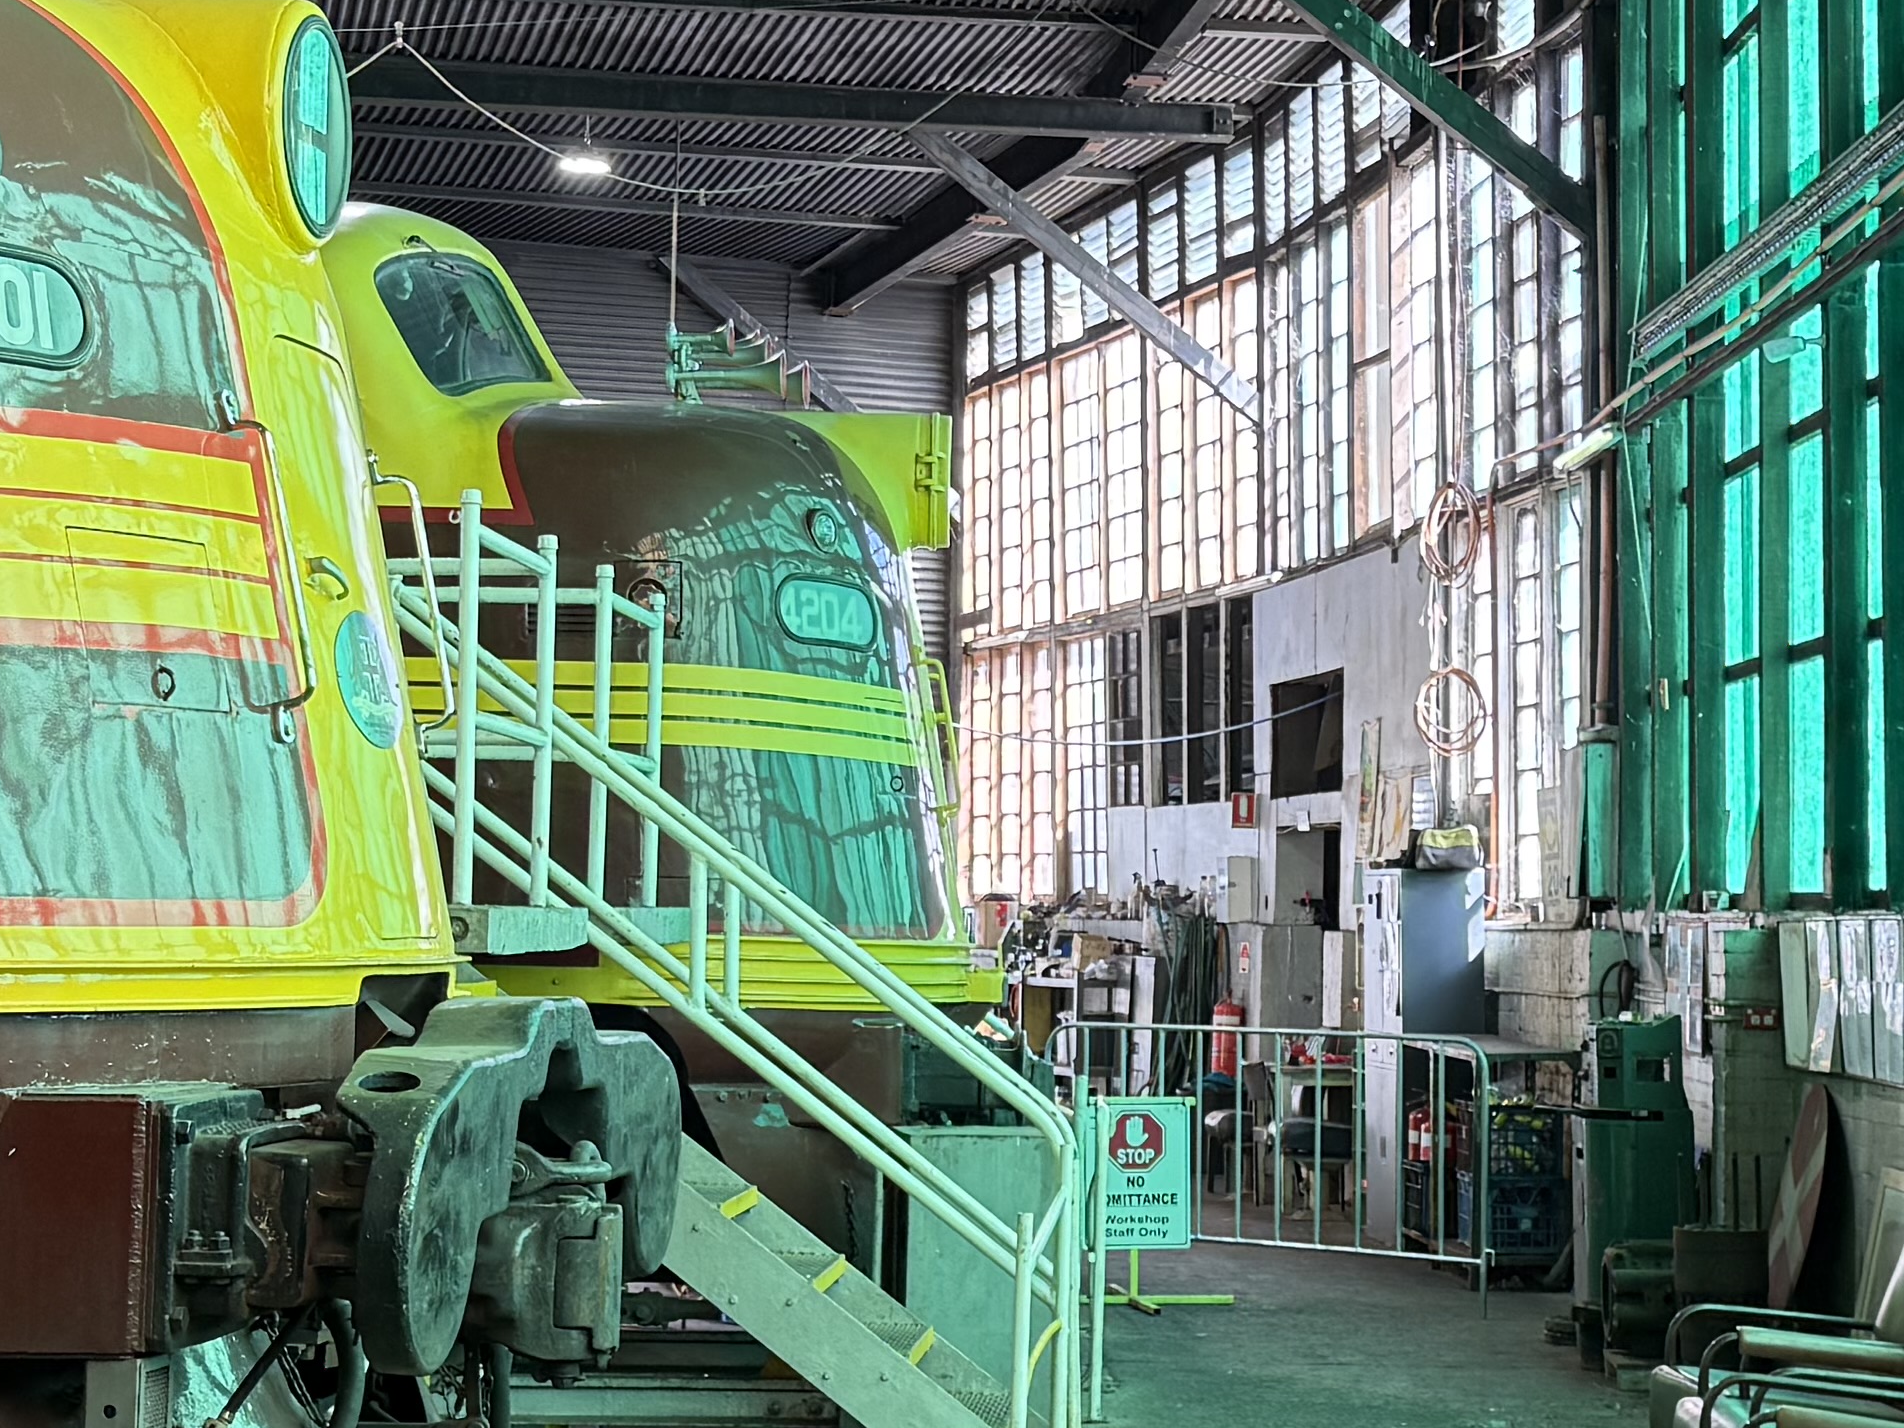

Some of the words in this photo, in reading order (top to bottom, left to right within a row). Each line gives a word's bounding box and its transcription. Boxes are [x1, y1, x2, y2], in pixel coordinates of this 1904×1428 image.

[781, 585, 863, 641] 4204
[1116, 1148, 1155, 1165] STOP
[1126, 1175, 1145, 1188] NO
[1106, 1192, 1178, 1207] MITTANCE
[1105, 1214, 1170, 1226] Workshop
[1105, 1227, 1135, 1238] Staff
[1138, 1227, 1169, 1239] Only
